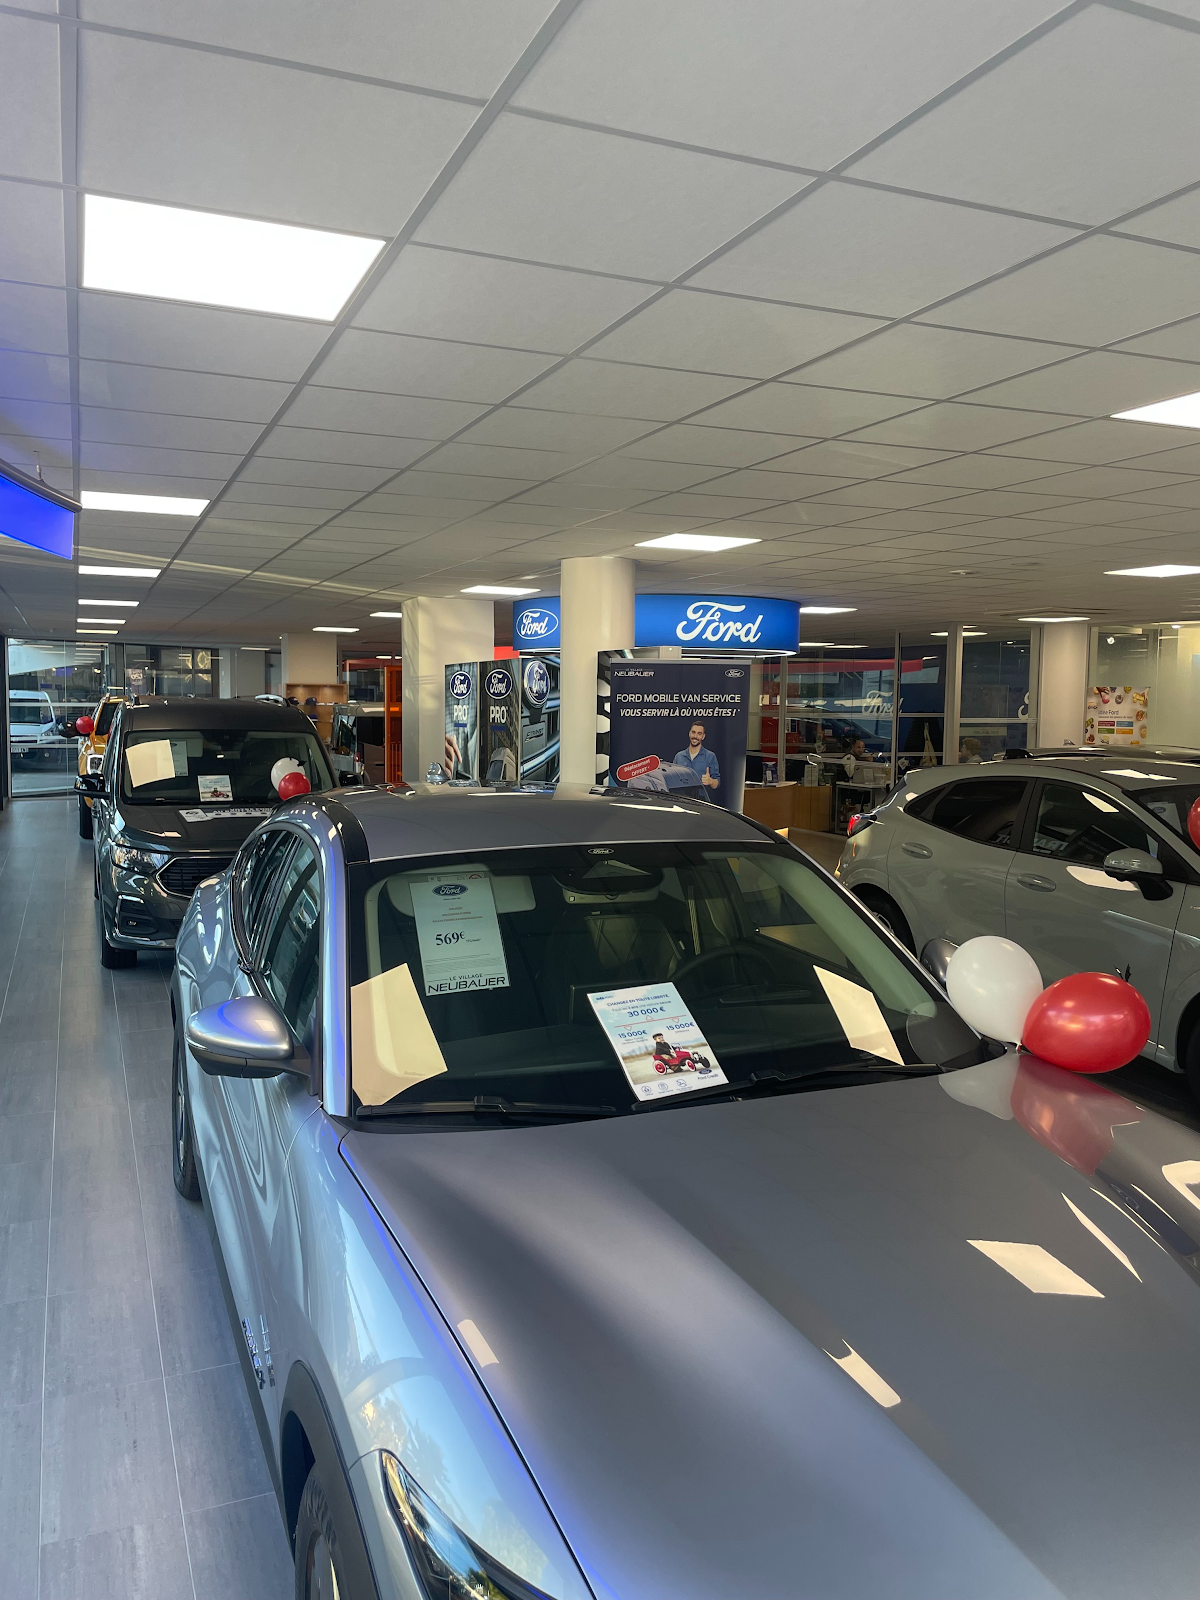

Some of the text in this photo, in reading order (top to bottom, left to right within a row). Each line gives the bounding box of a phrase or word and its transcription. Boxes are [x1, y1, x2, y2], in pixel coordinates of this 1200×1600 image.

[520, 612, 548, 635] Ford
[676, 601, 764, 643] Ford
[453, 674, 468, 694] Ford
[489, 673, 508, 694] Ford
[616, 694, 741, 702] FORD MOBILE VAN SERVICE
[453, 705, 468, 721] PRO
[489, 705, 507, 724] PRO
[620, 708, 641, 717] VOUS
[641, 708, 670, 717] SERVIR
[669, 706, 680, 717] LÀ
[680, 706, 691, 717] OÙ
[692, 708, 713, 717] VOUS
[713, 706, 732, 717] ÊTES
[440, 885, 461, 895] Ford
[435, 930, 466, 946] 569€
[458, 972, 484, 980] VILLAGE
[428, 976, 506, 993] NEUBAUER
[640, 1006, 659, 1016] 000
